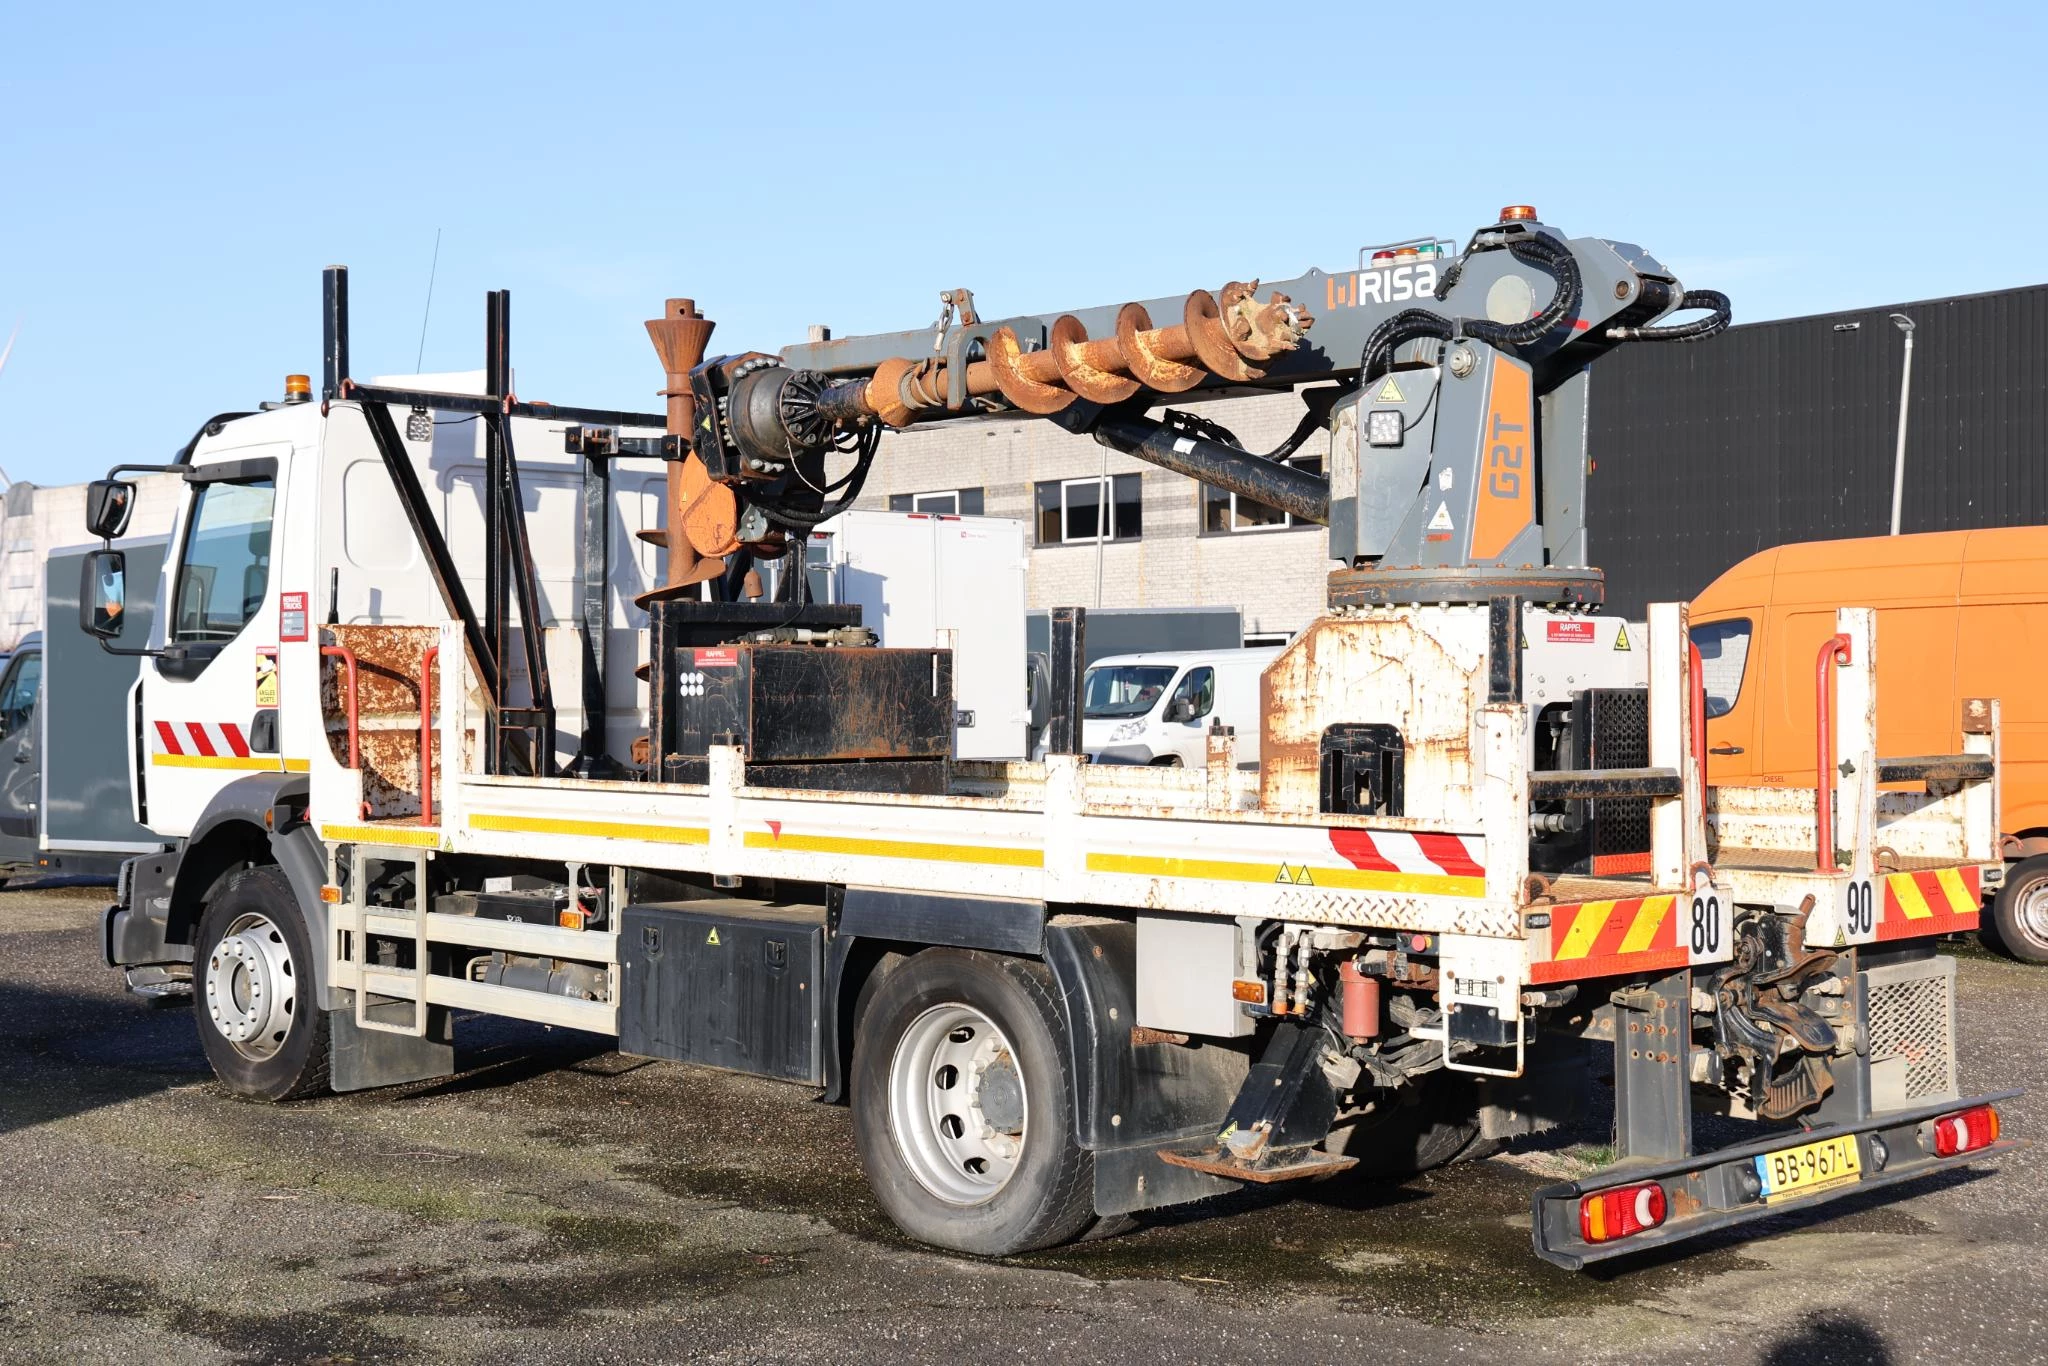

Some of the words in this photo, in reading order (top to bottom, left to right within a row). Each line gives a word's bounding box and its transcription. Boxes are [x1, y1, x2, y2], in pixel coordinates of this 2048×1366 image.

[1489, 413, 1523, 499] G2T
[1560, 623, 1583, 632] RAPPEL
[705, 650, 727, 658] RAPPEL
[1691, 896, 1719, 955] 80
[1847, 881, 1872, 935] 90
[1774, 1142, 1854, 1186] BB-967-L
